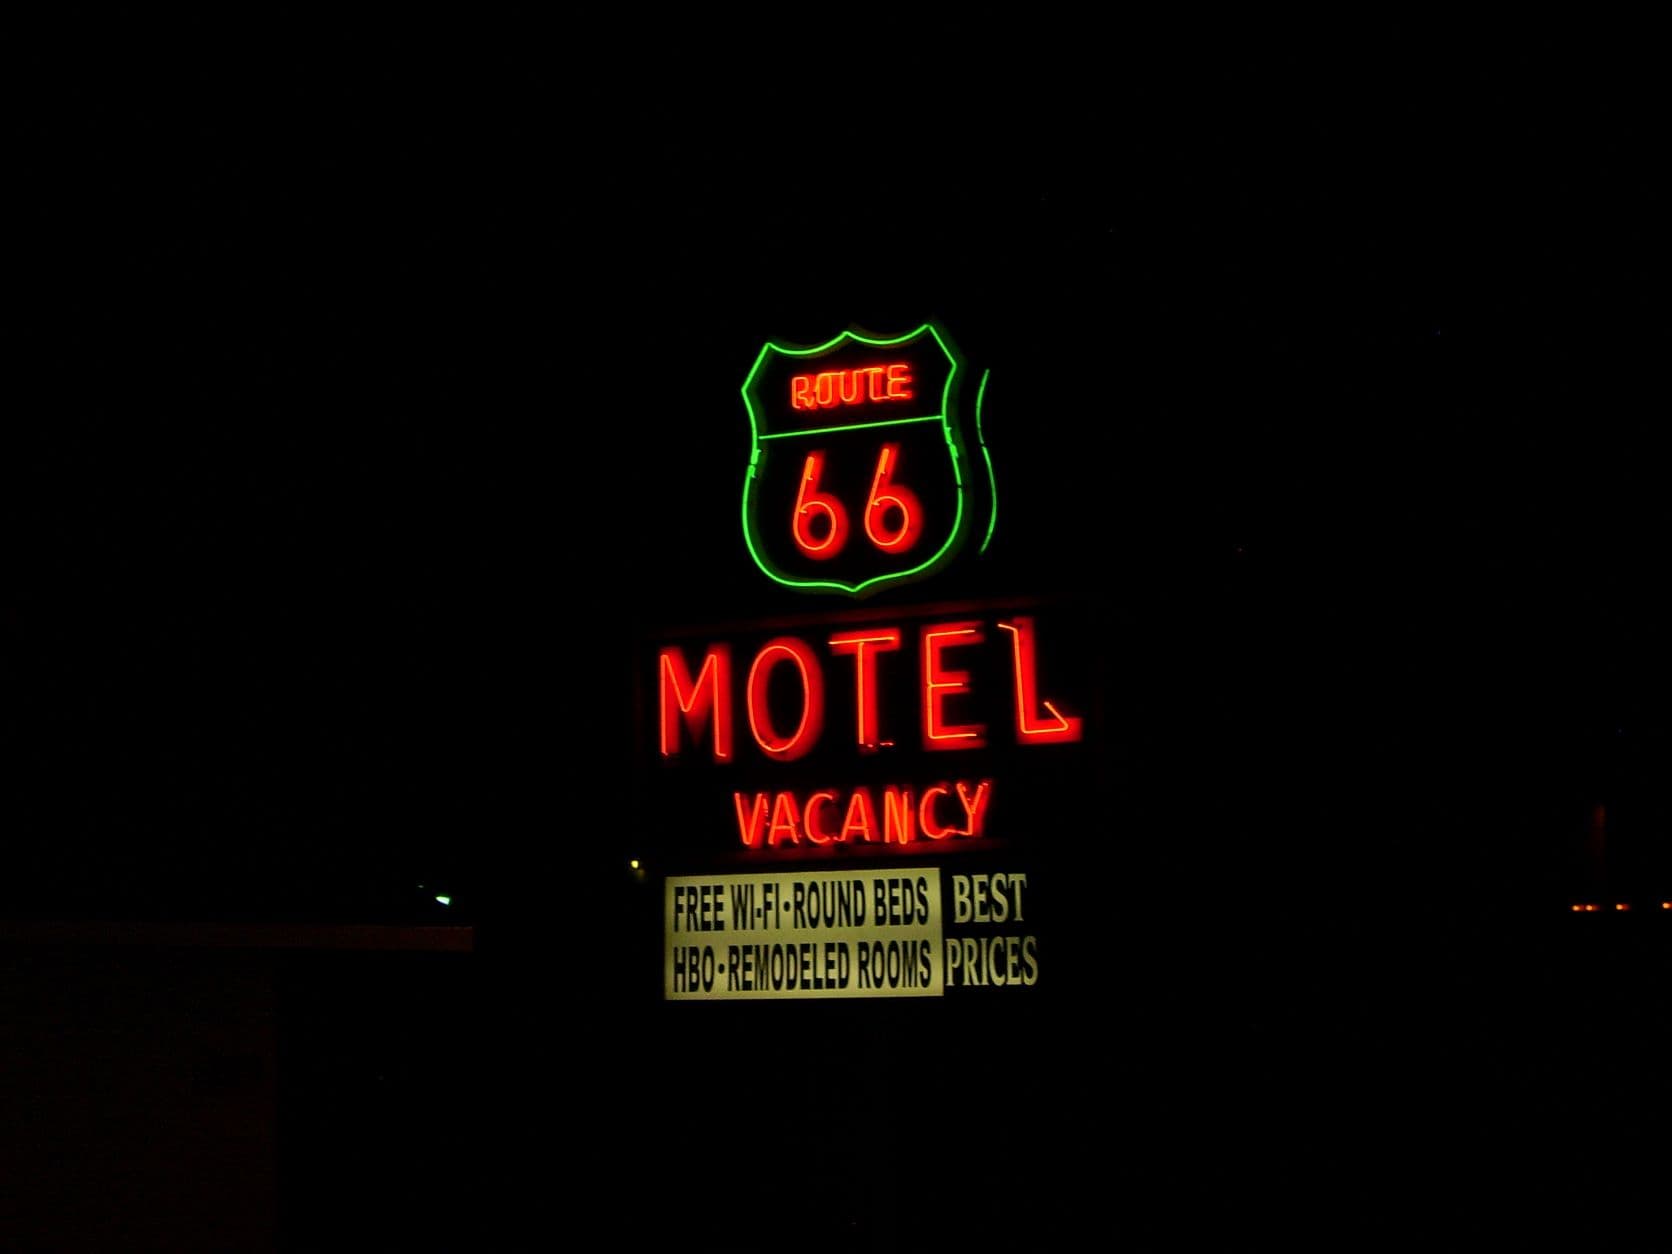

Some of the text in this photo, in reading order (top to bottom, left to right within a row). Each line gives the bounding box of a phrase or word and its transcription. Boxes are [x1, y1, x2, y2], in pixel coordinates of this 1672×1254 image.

[791, 363, 912, 411] ROUTE
[791, 445, 922, 558] 66
[657, 615, 1083, 762] MOTEL
[733, 780, 992, 846] VACANCY
[673, 885, 725, 932] FREE
[873, 876, 929, 927] BEDS
[951, 871, 1028, 925] BEST
[857, 939, 931, 989] ROOMS
[944, 934, 1039, 988] PRICES
